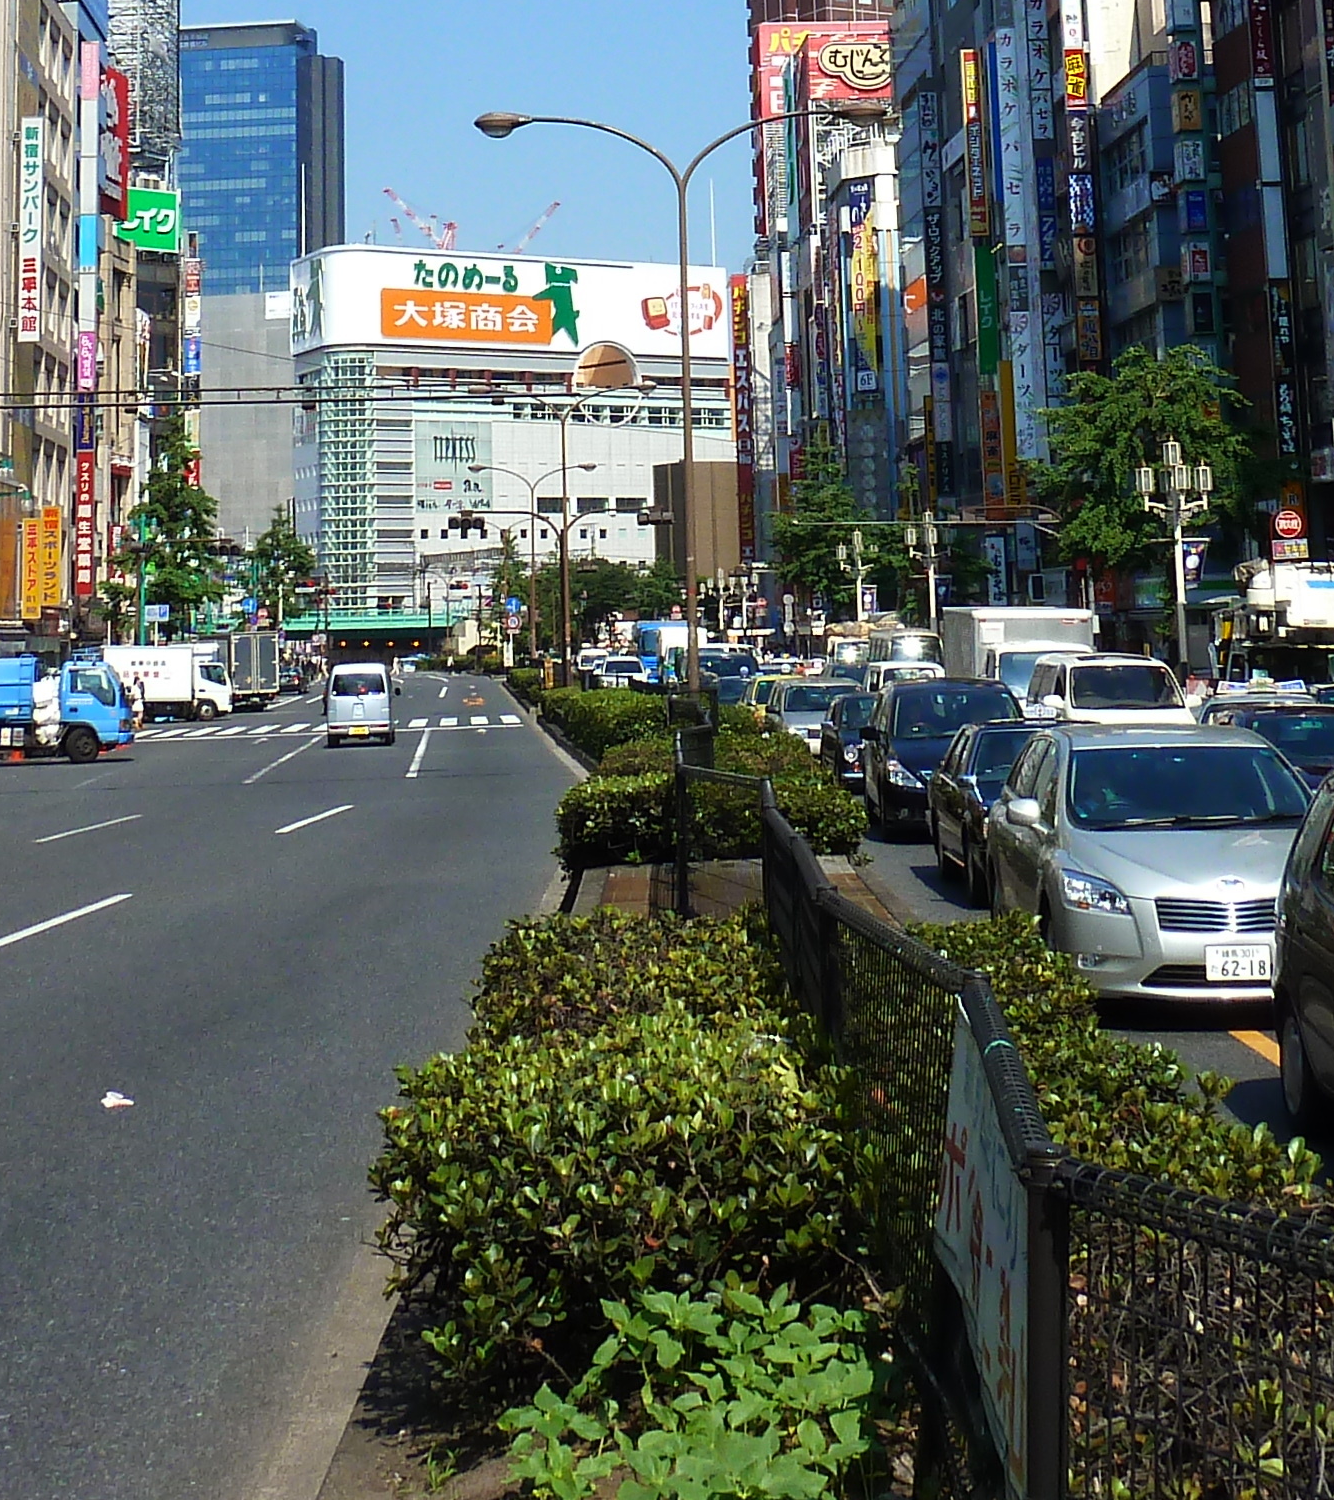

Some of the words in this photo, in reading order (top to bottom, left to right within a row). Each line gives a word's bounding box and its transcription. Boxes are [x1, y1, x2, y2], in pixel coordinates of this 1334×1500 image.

[1000, 33, 1017, 117] カラオケ
[23, 127, 41, 244] 新宿サンパーク
[414, 260, 518, 293] たのめーる
[926, 211, 942, 284] ザロックアップ
[20, 257, 38, 332] 三平本館
[392, 301, 539, 334] 大塚商会
[731, 285, 747, 344] パチンコ
[42, 508, 59, 602] 新宿スポーツランド
[1221, 960, 1267, 977] 62-18
